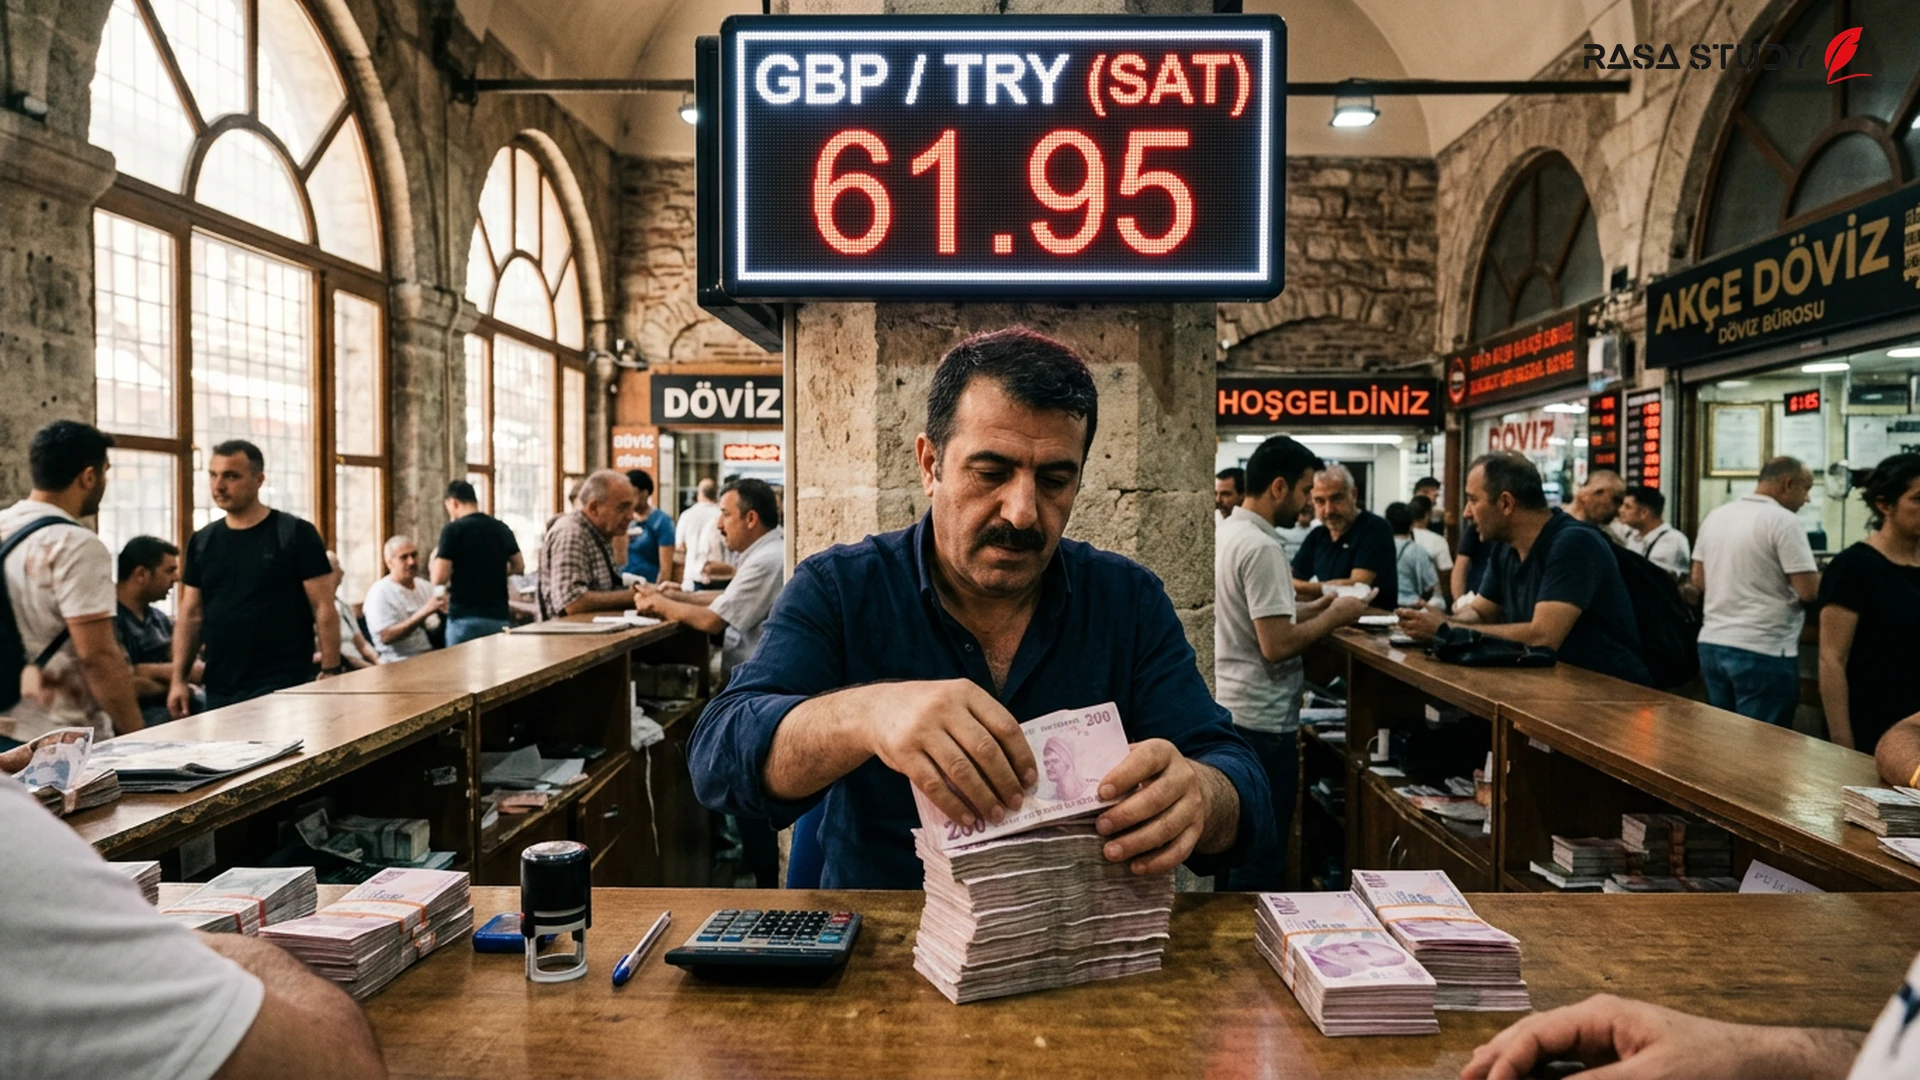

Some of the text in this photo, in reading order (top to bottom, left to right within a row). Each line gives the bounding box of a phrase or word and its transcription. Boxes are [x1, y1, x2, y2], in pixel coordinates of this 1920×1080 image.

[755, 54, 1250, 116] GBP / TRY (SAT)
[813, 129, 1193, 255] 61.95
[1655, 213, 1890, 334] AKÇE DÖVİZ
[1762, 300, 1825, 334] BÜROSU
[664, 381, 781, 419] DÖVİZ
[1218, 384, 1430, 421] HOŞGELDİNİZ
[1084, 710, 1111, 727] 200
